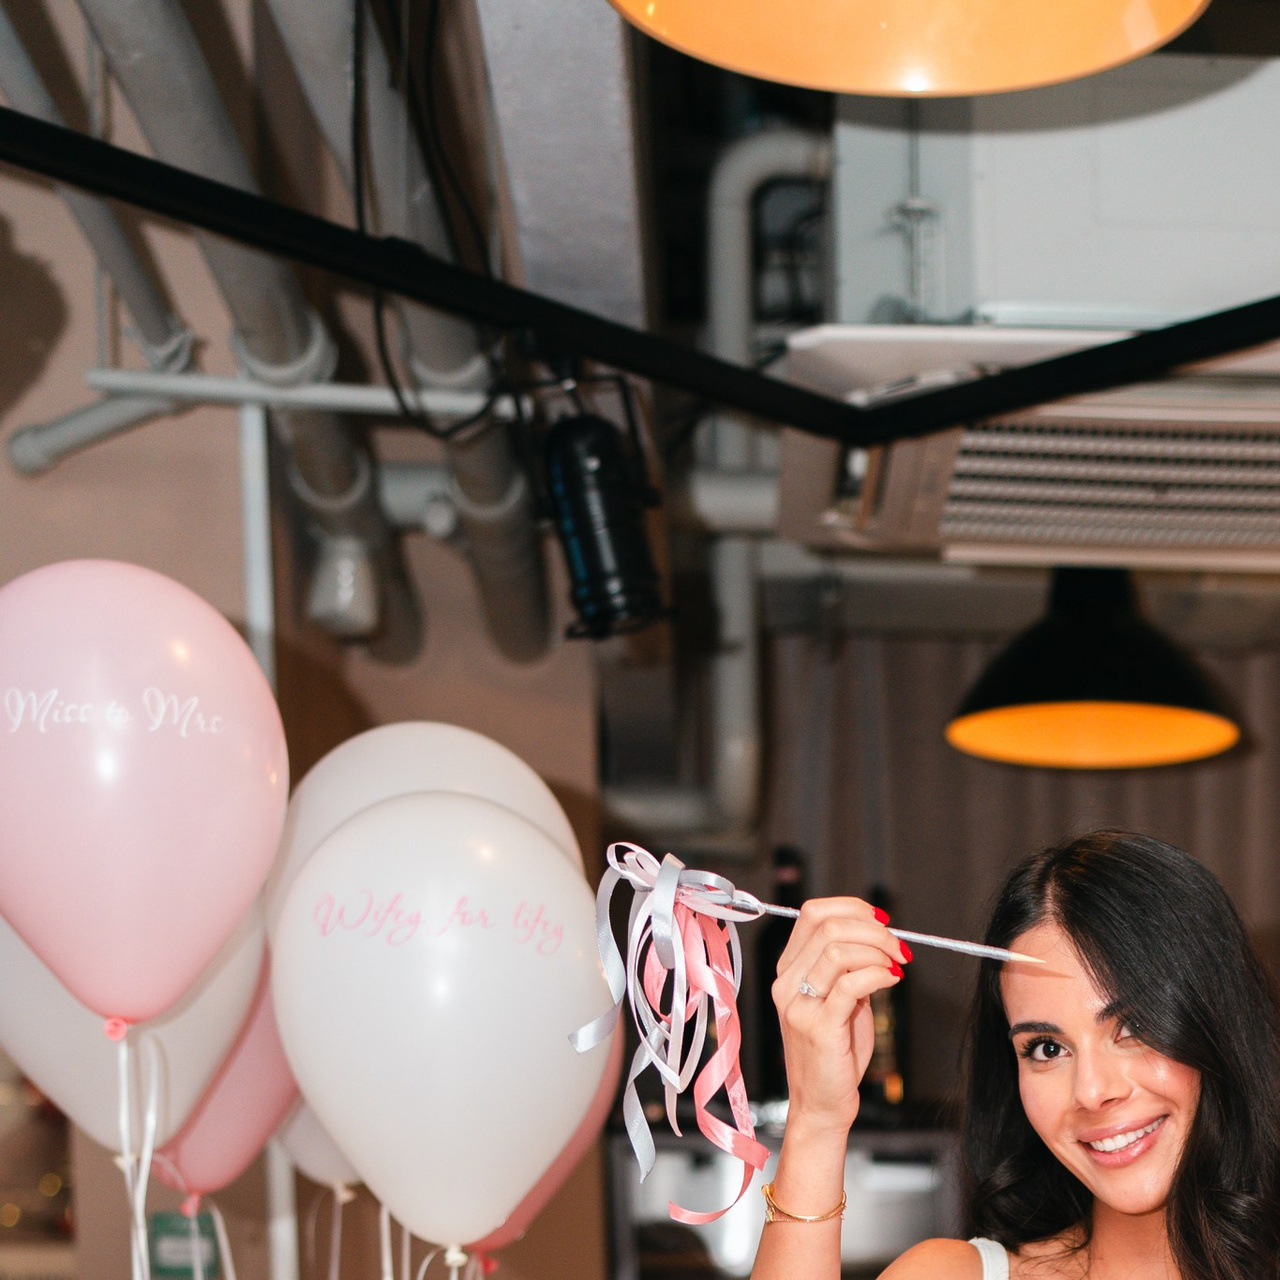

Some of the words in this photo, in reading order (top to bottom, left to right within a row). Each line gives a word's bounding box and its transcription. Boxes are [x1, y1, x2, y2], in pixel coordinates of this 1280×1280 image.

[5, 687, 94, 733] Miss
[143, 686, 223, 738] Mrs
[435, 895, 494, 937] for
